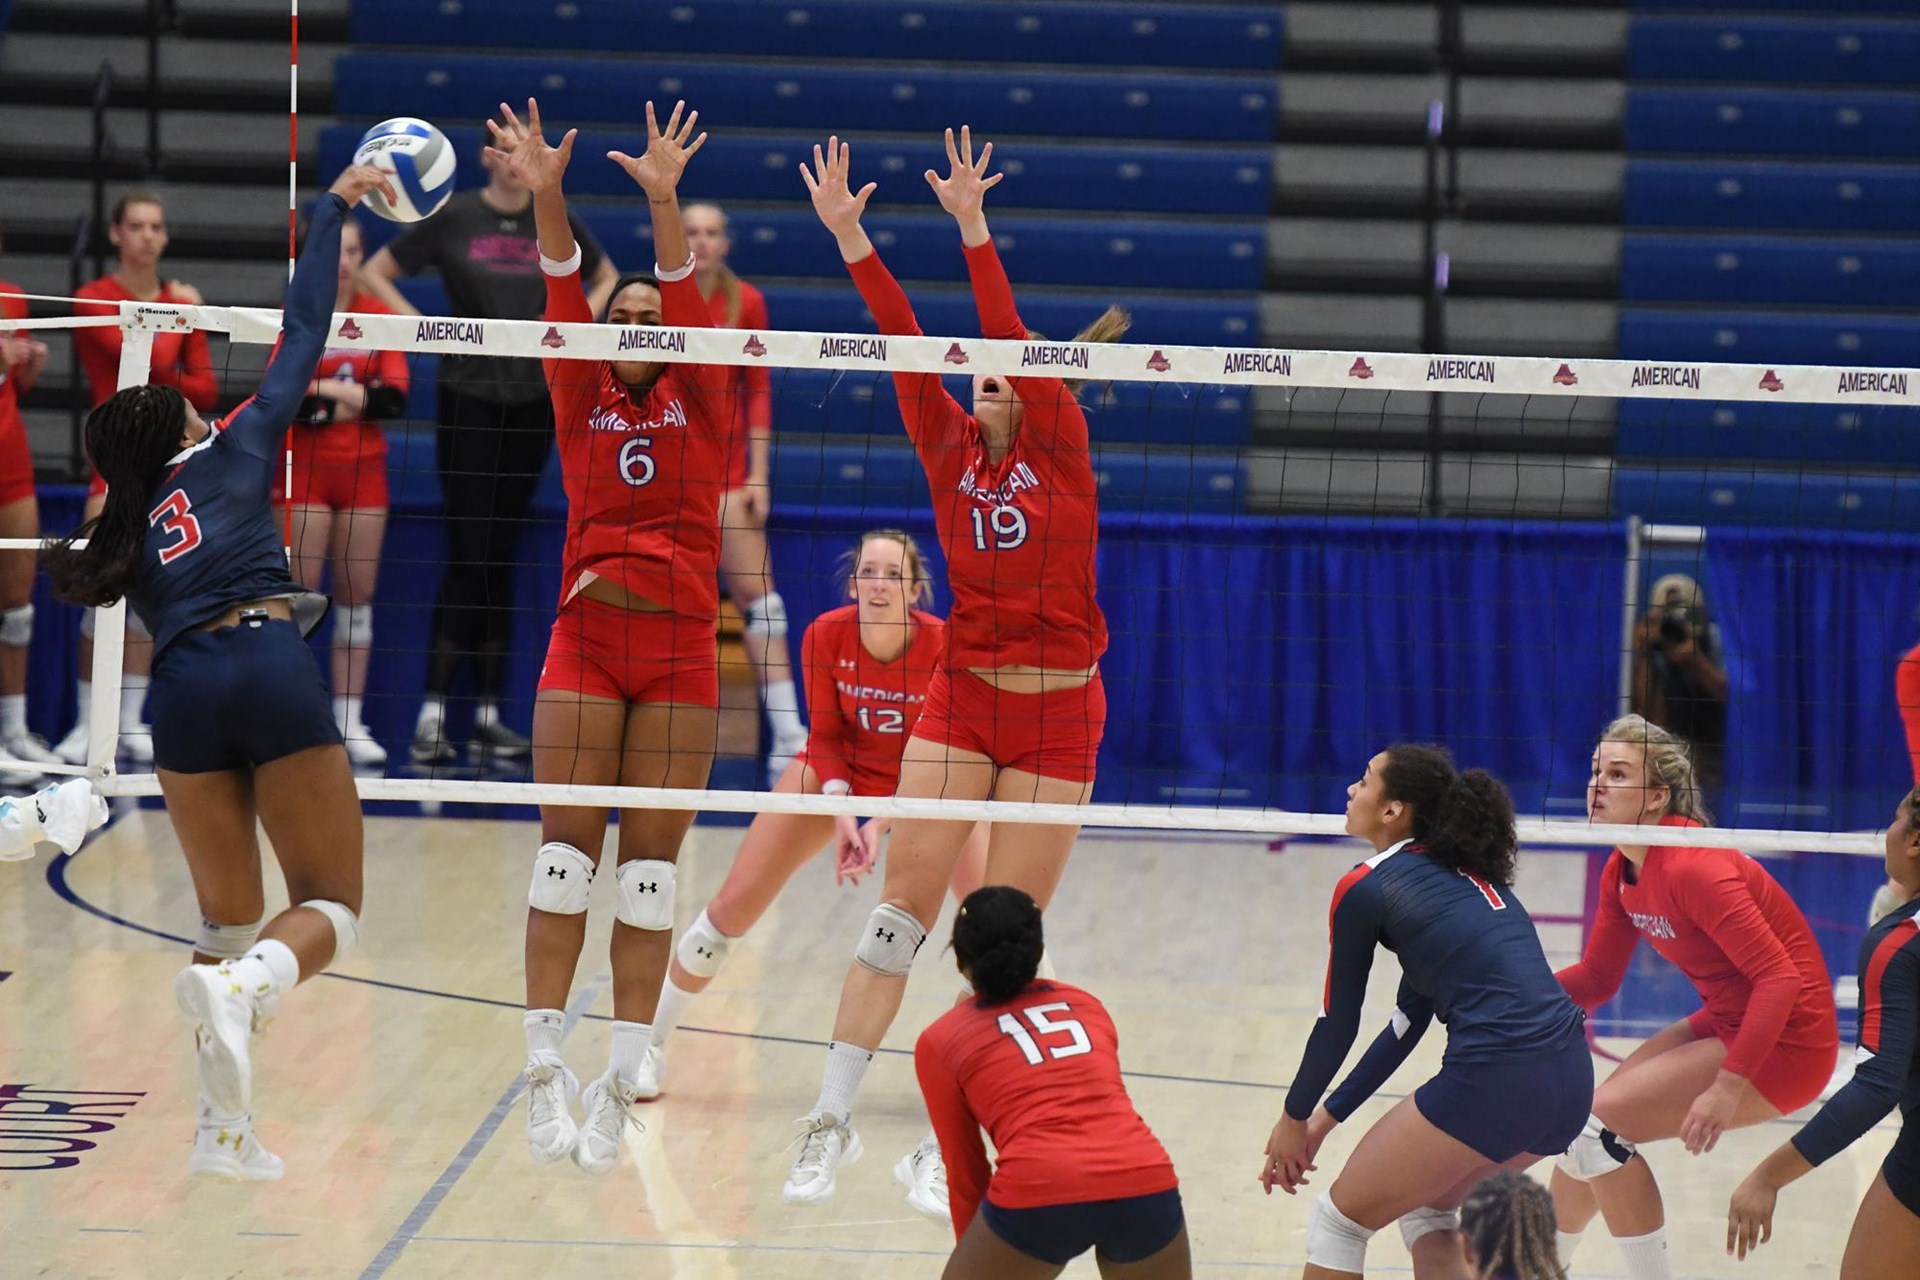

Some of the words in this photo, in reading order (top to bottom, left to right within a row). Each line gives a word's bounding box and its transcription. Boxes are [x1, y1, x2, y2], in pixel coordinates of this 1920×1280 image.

[416, 321, 484, 345] AMERICAN
[618, 329, 686, 353] AMERICAN
[819, 338, 887, 361] AMERICAN
[1021, 345, 1089, 369] AMERICAN
[1223, 353, 1291, 376] AMERICAN
[1426, 359, 1495, 383] AMERICAN
[1631, 366, 1700, 390] AMERICAN
[1837, 372, 1907, 395] AMERICAN
[619, 438, 655, 486] 6
[148, 487, 202, 566] 3
[972, 505, 1027, 550] 19
[858, 706, 904, 734] 12
[997, 1001, 1093, 1067] 15
